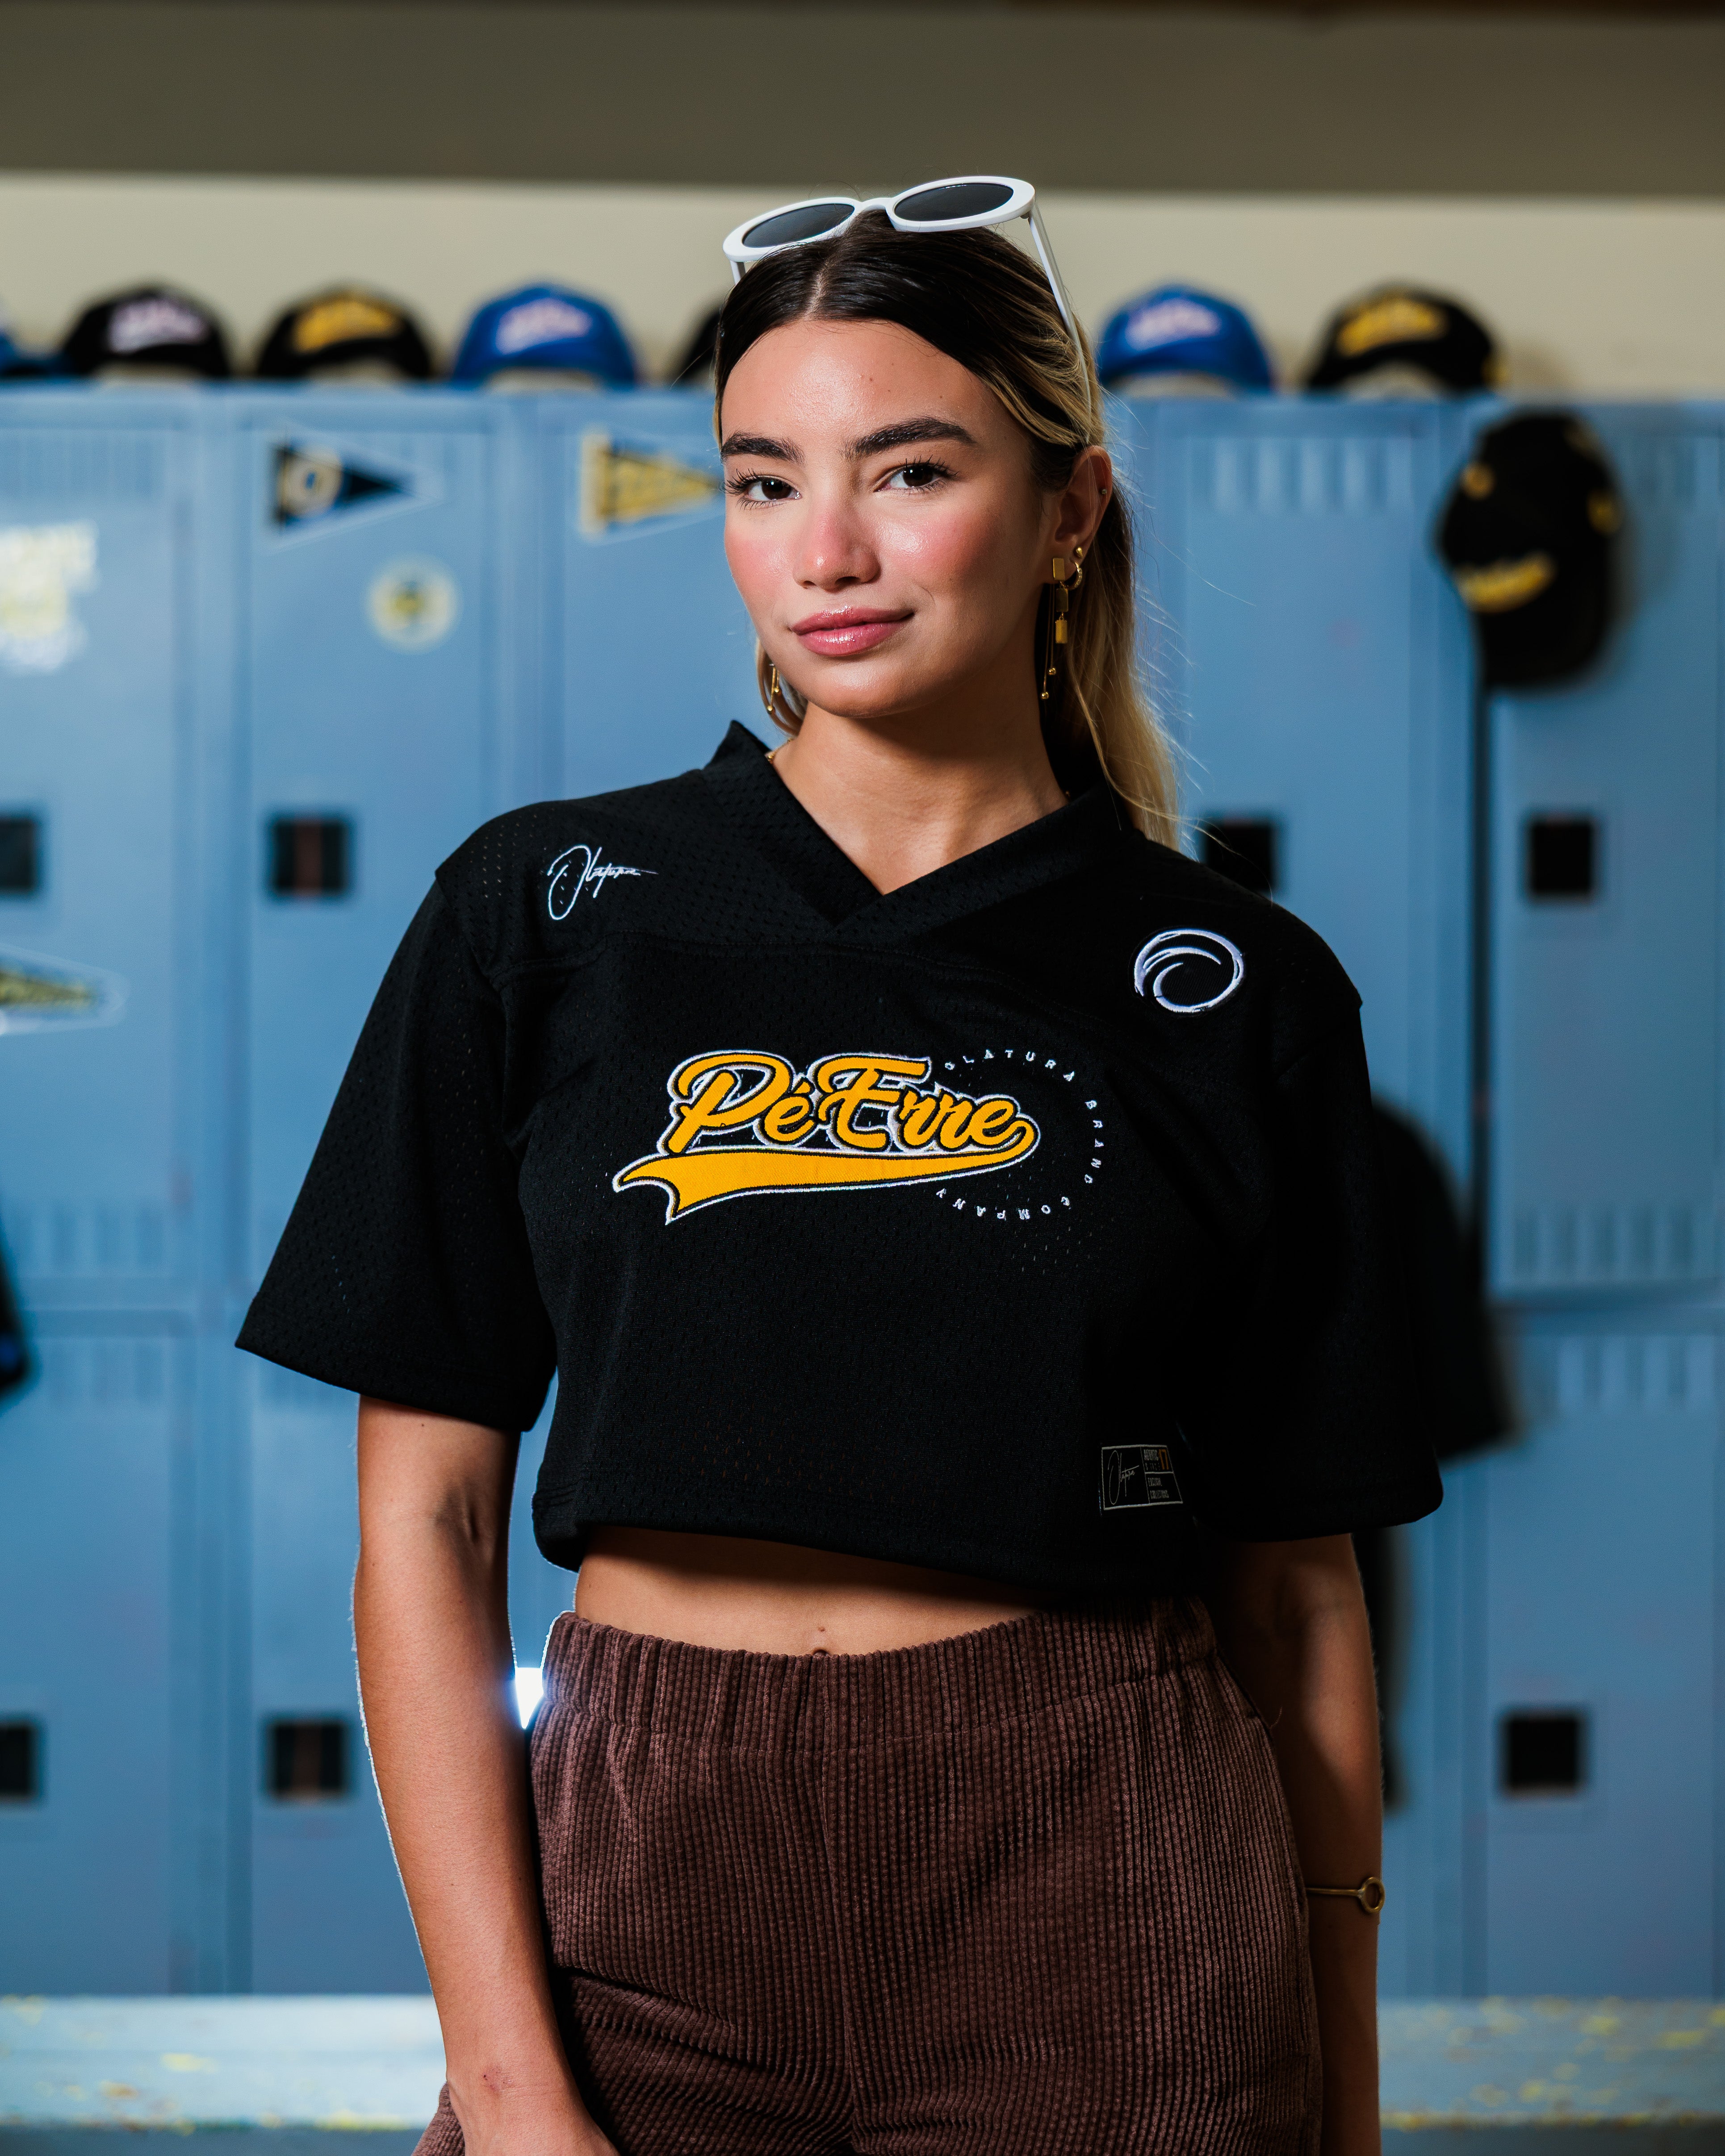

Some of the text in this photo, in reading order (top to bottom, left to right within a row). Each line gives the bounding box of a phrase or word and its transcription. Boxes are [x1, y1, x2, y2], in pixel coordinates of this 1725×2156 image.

[935, 1049, 1105, 1222] OLATURA BRAND COMPANY
